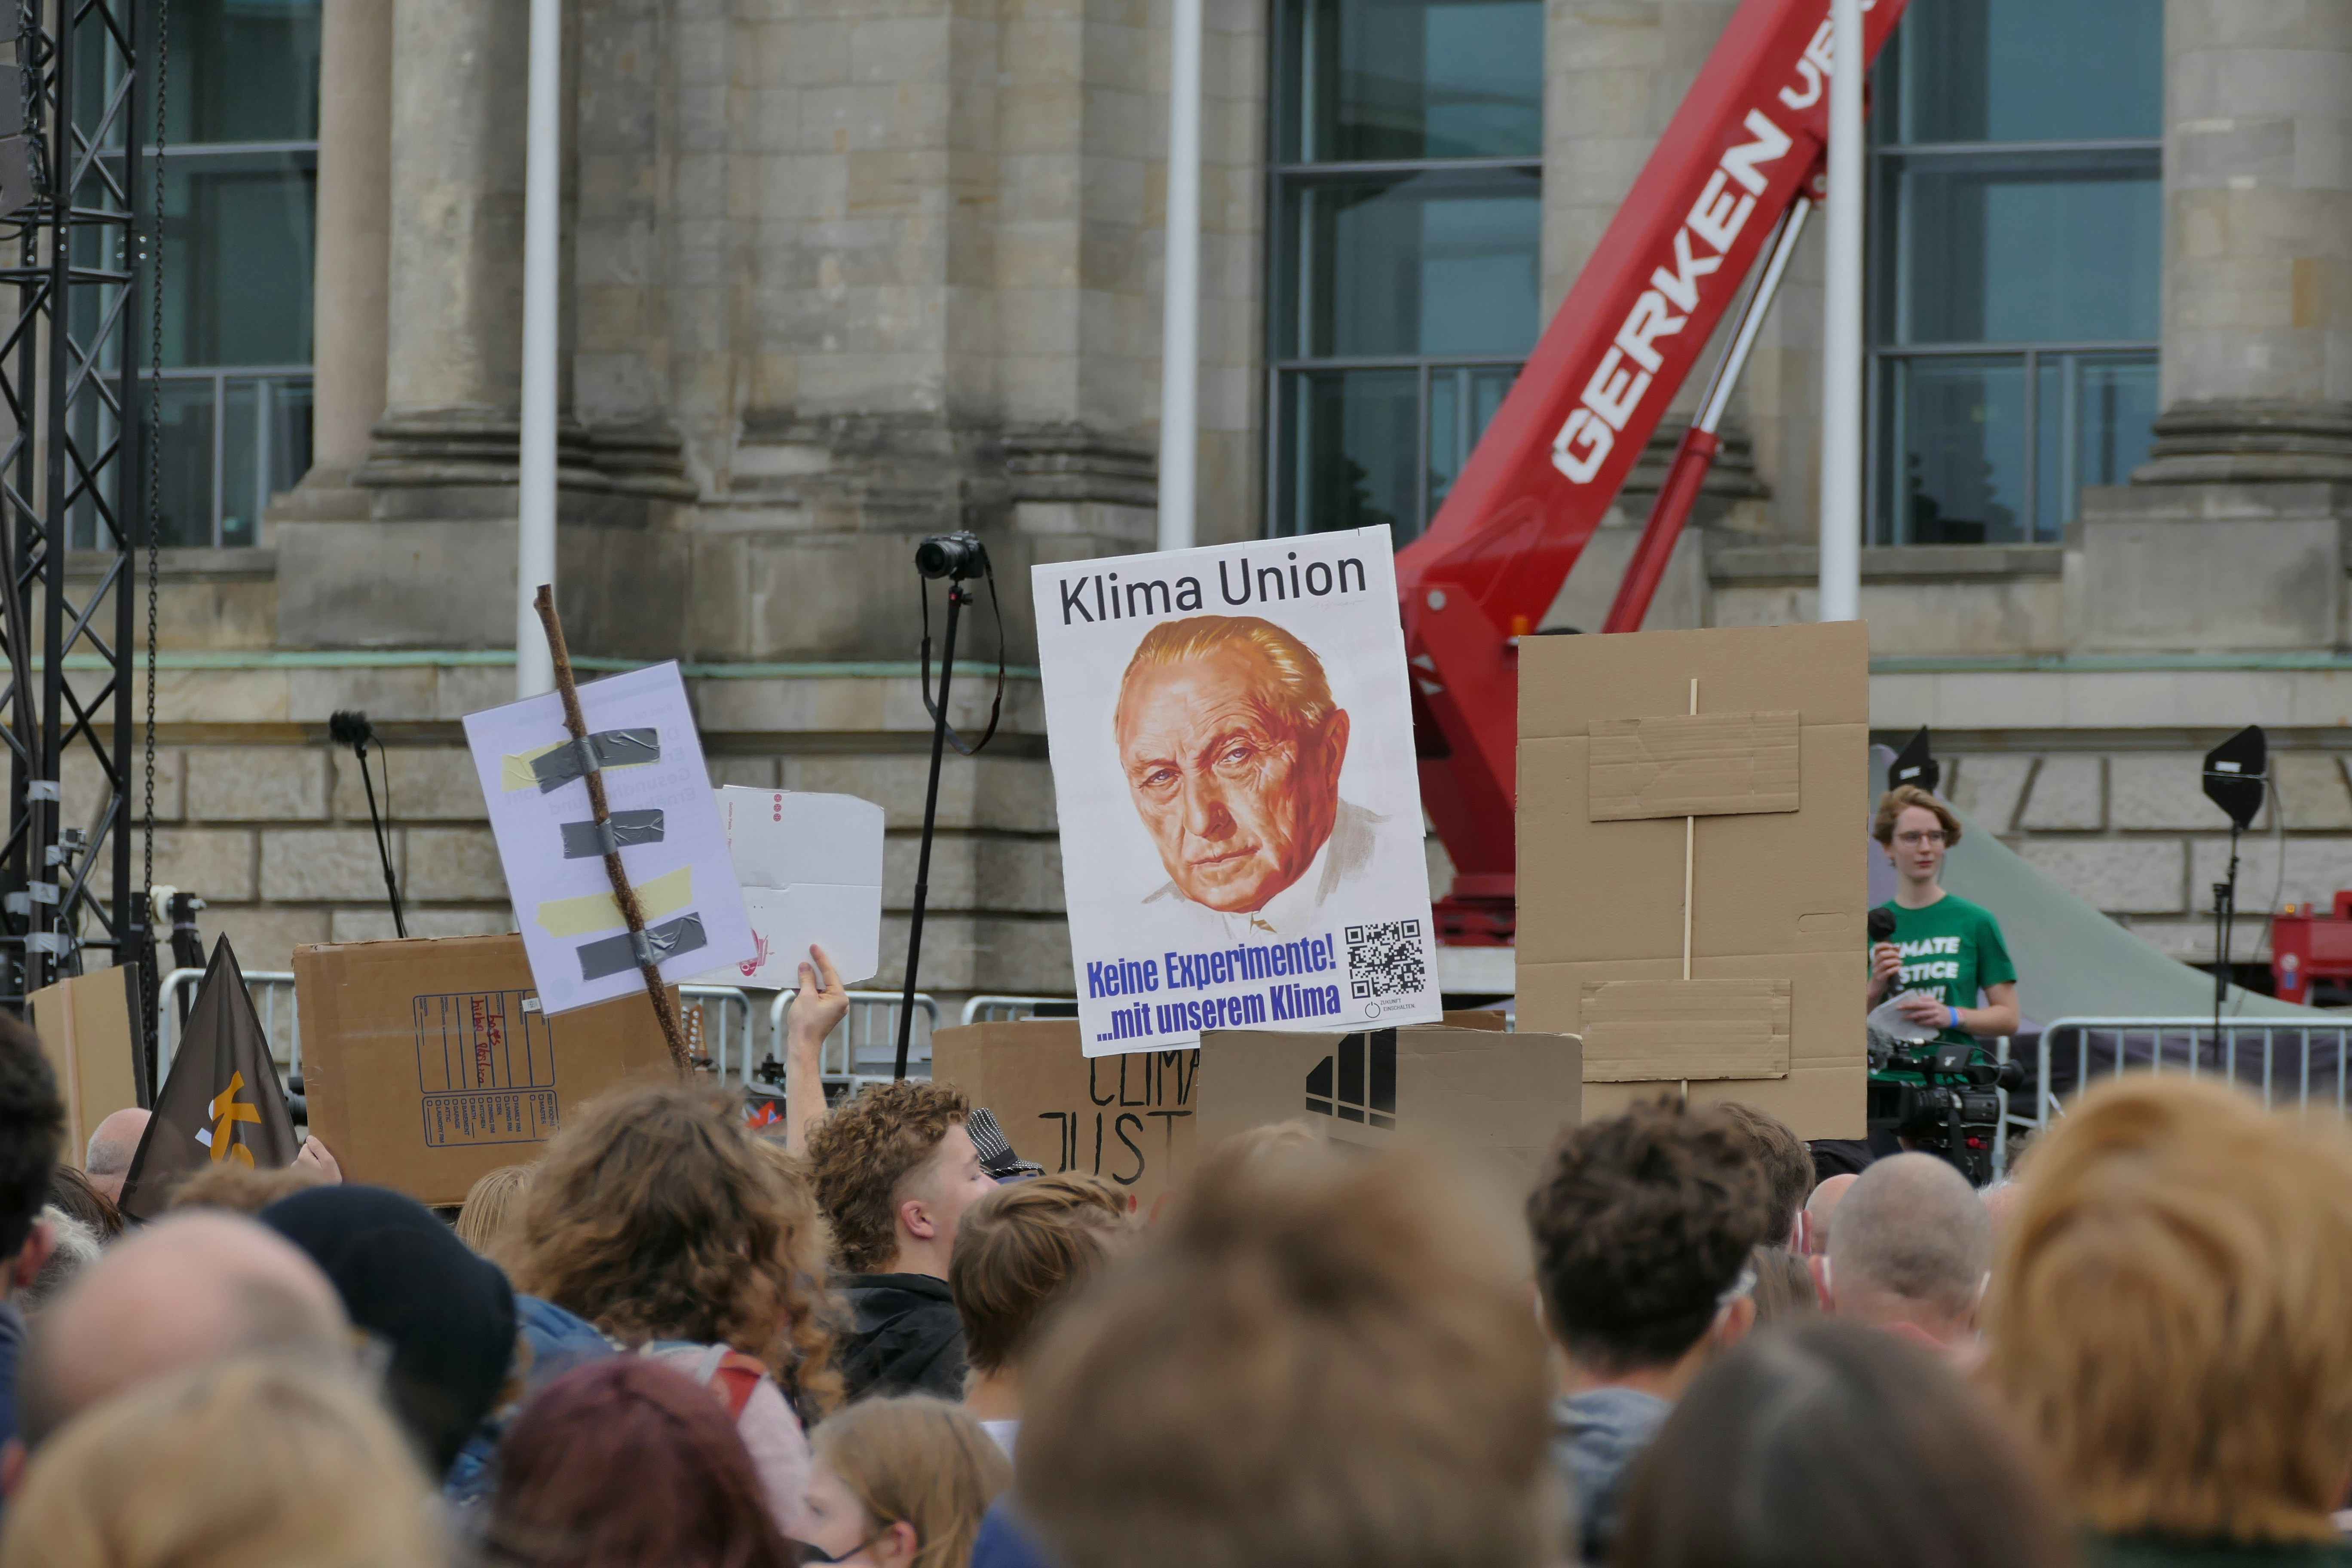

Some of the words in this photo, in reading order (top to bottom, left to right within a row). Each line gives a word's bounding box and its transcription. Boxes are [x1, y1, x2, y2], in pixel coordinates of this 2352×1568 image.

[1550, 107, 1793, 485] GERKEN
[1060, 572, 1203, 625] Klima
[1219, 551, 1366, 606] Union
[1087, 958, 1159, 998] Keine
[1164, 933, 1337, 990] Experimente!
[1097, 1002, 1153, 1042] ...mit
[1157, 993, 1266, 1034] unserem
[1270, 983, 1341, 1021] Klima
[438, 1133, 444, 1143] RM
[490, 1124, 495, 1133] RM
[507, 1122, 512, 1132] RM
[515, 1123, 521, 1132] RM
[1038, 1110, 1193, 1185] JUST
